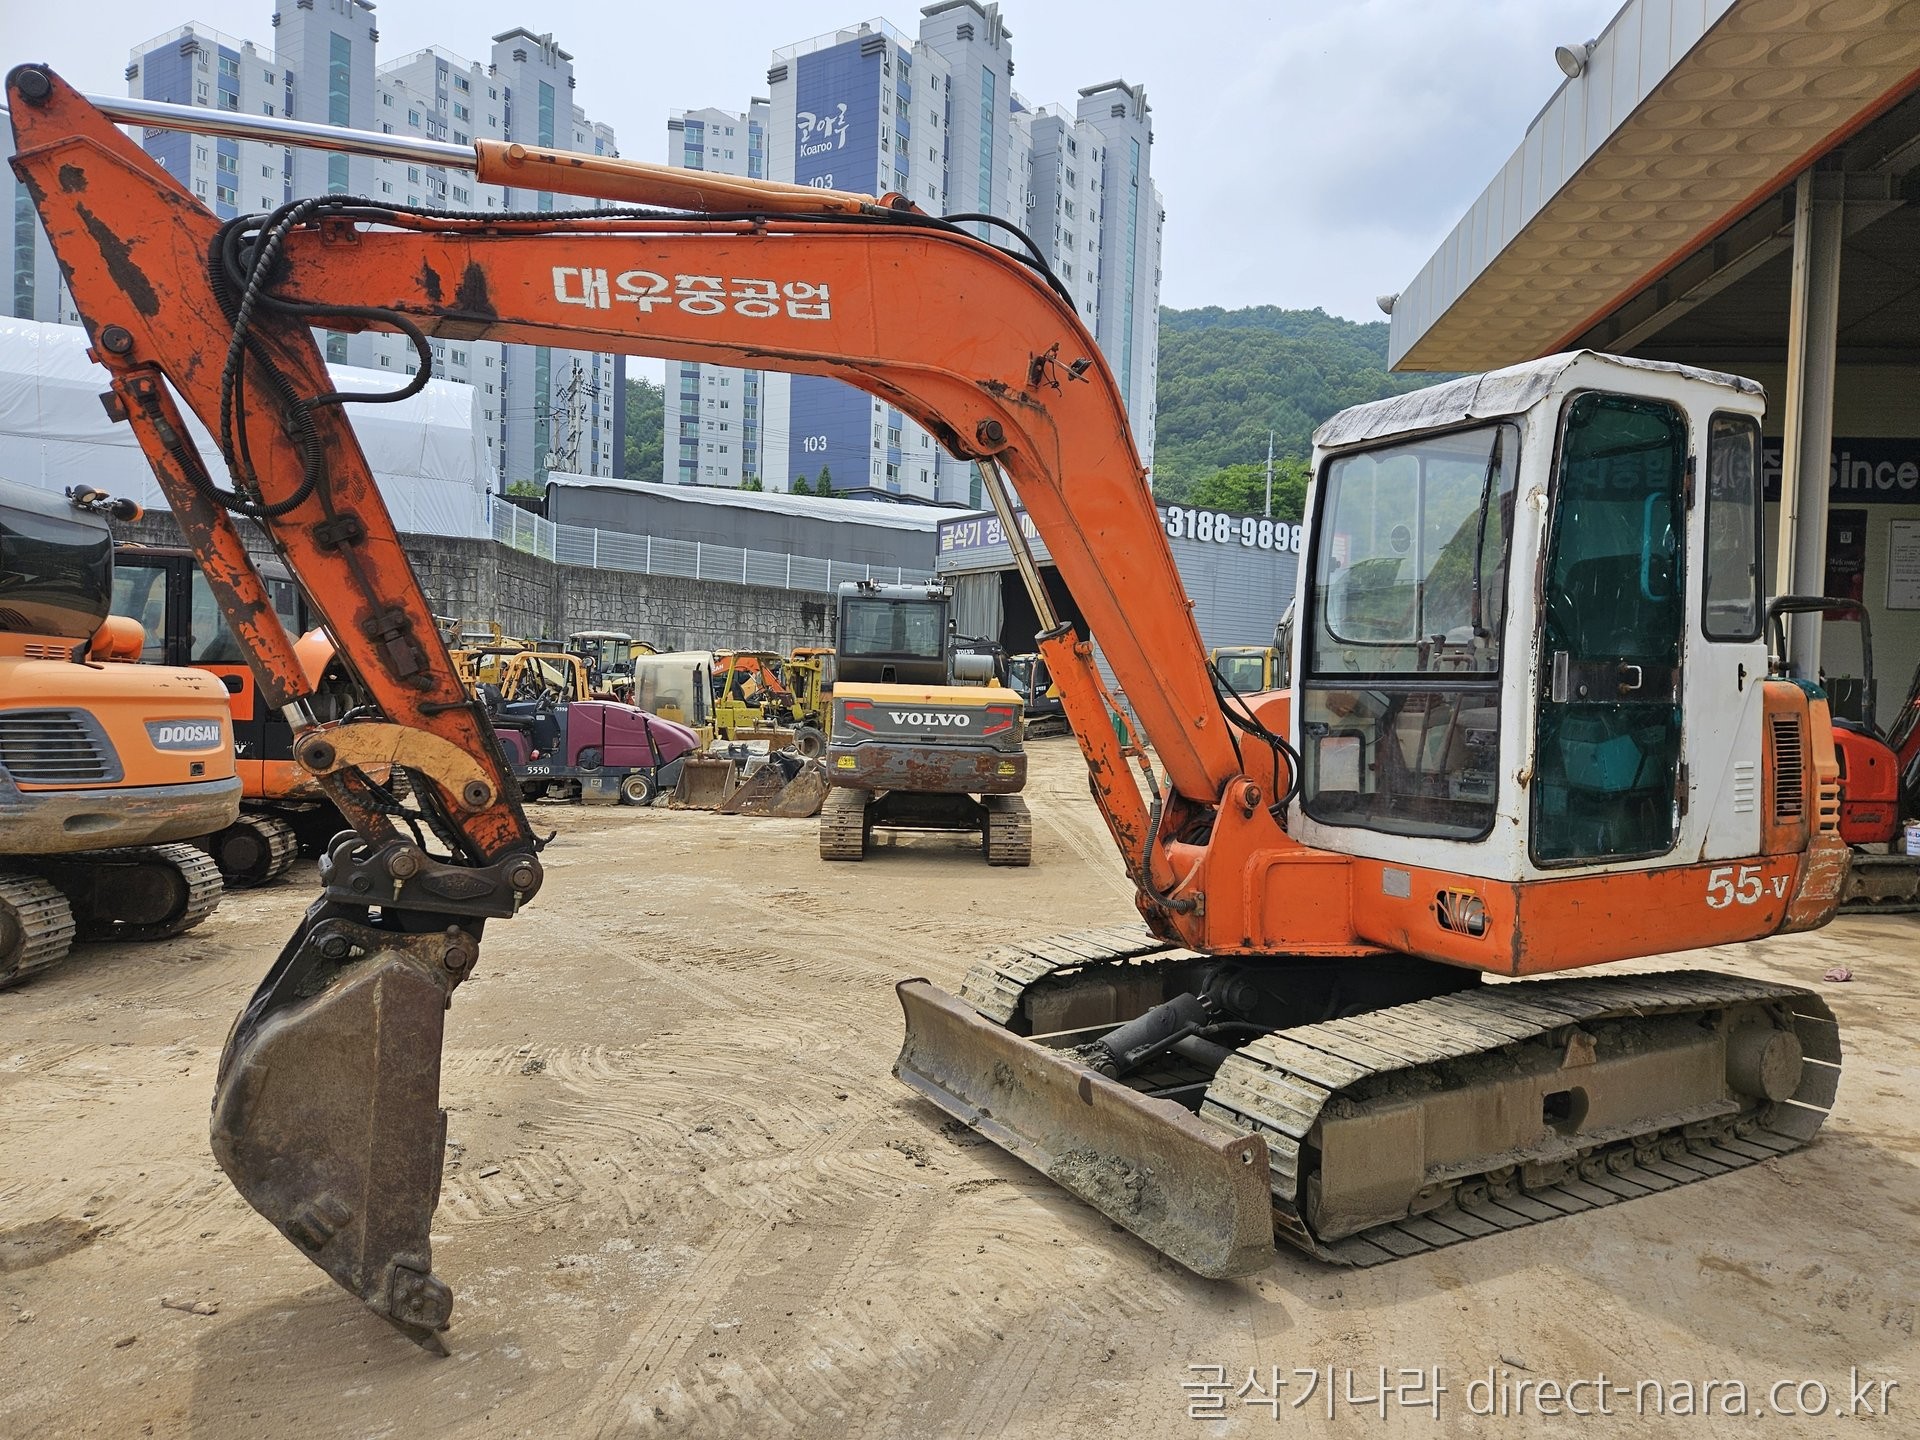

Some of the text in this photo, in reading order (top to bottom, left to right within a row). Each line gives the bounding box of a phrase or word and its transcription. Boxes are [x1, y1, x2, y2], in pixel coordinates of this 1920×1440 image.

[800, 141, 833, 157] Koaroo
[809, 174, 833, 189] 103
[552, 266, 832, 320] 대우중공업
[803, 435, 827, 453] 103
[942, 521, 981, 551] 굴삭기
[888, 712, 970, 727] VOLVO
[159, 726, 219, 743] DOOSAN
[527, 766, 550, 775] 5550
[1706, 866, 1790, 909] 55-V
